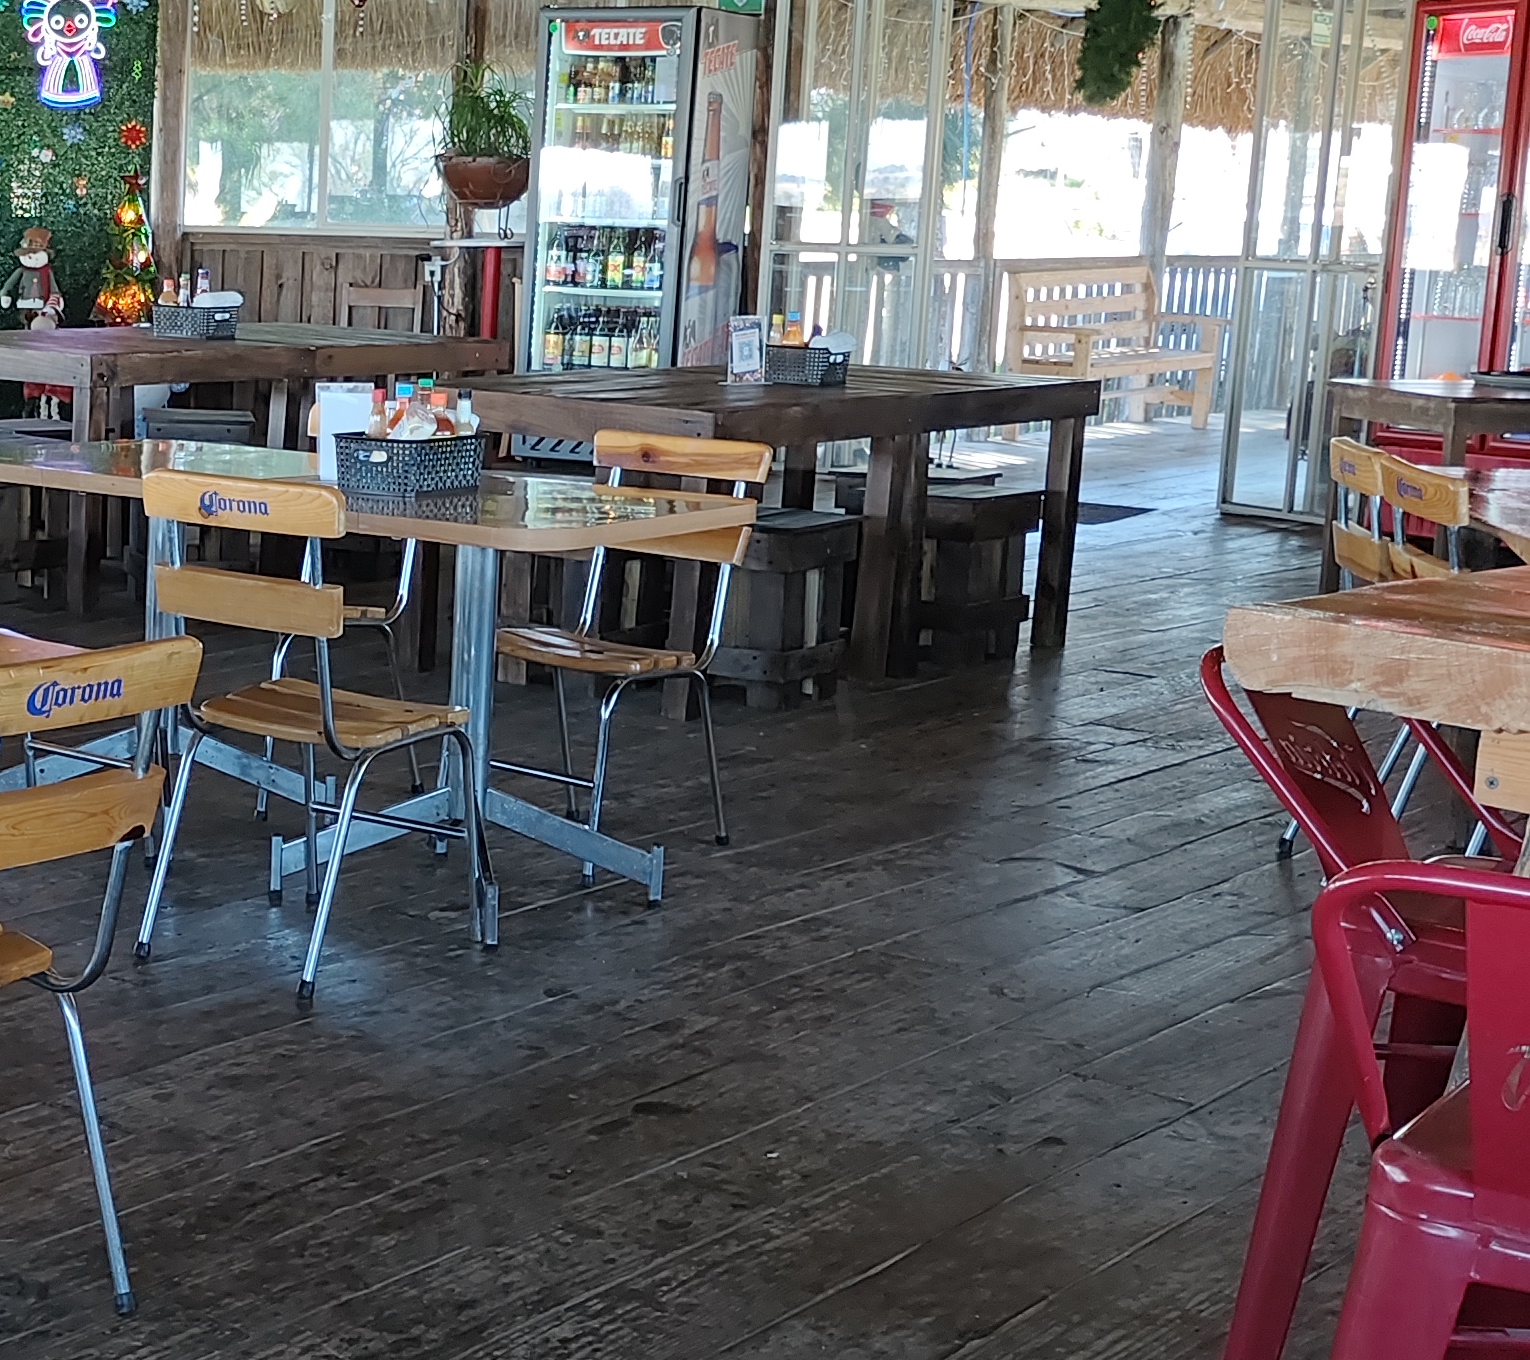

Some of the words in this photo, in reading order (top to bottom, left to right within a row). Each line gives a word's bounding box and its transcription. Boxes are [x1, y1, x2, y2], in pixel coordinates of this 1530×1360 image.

[591, 27, 647, 46] TECATE
[1463, 23, 1509, 44] Coca-Cola
[700, 40, 739, 77] TECATE
[199, 490, 270, 516] Corona
[26, 677, 123, 719] Corona
